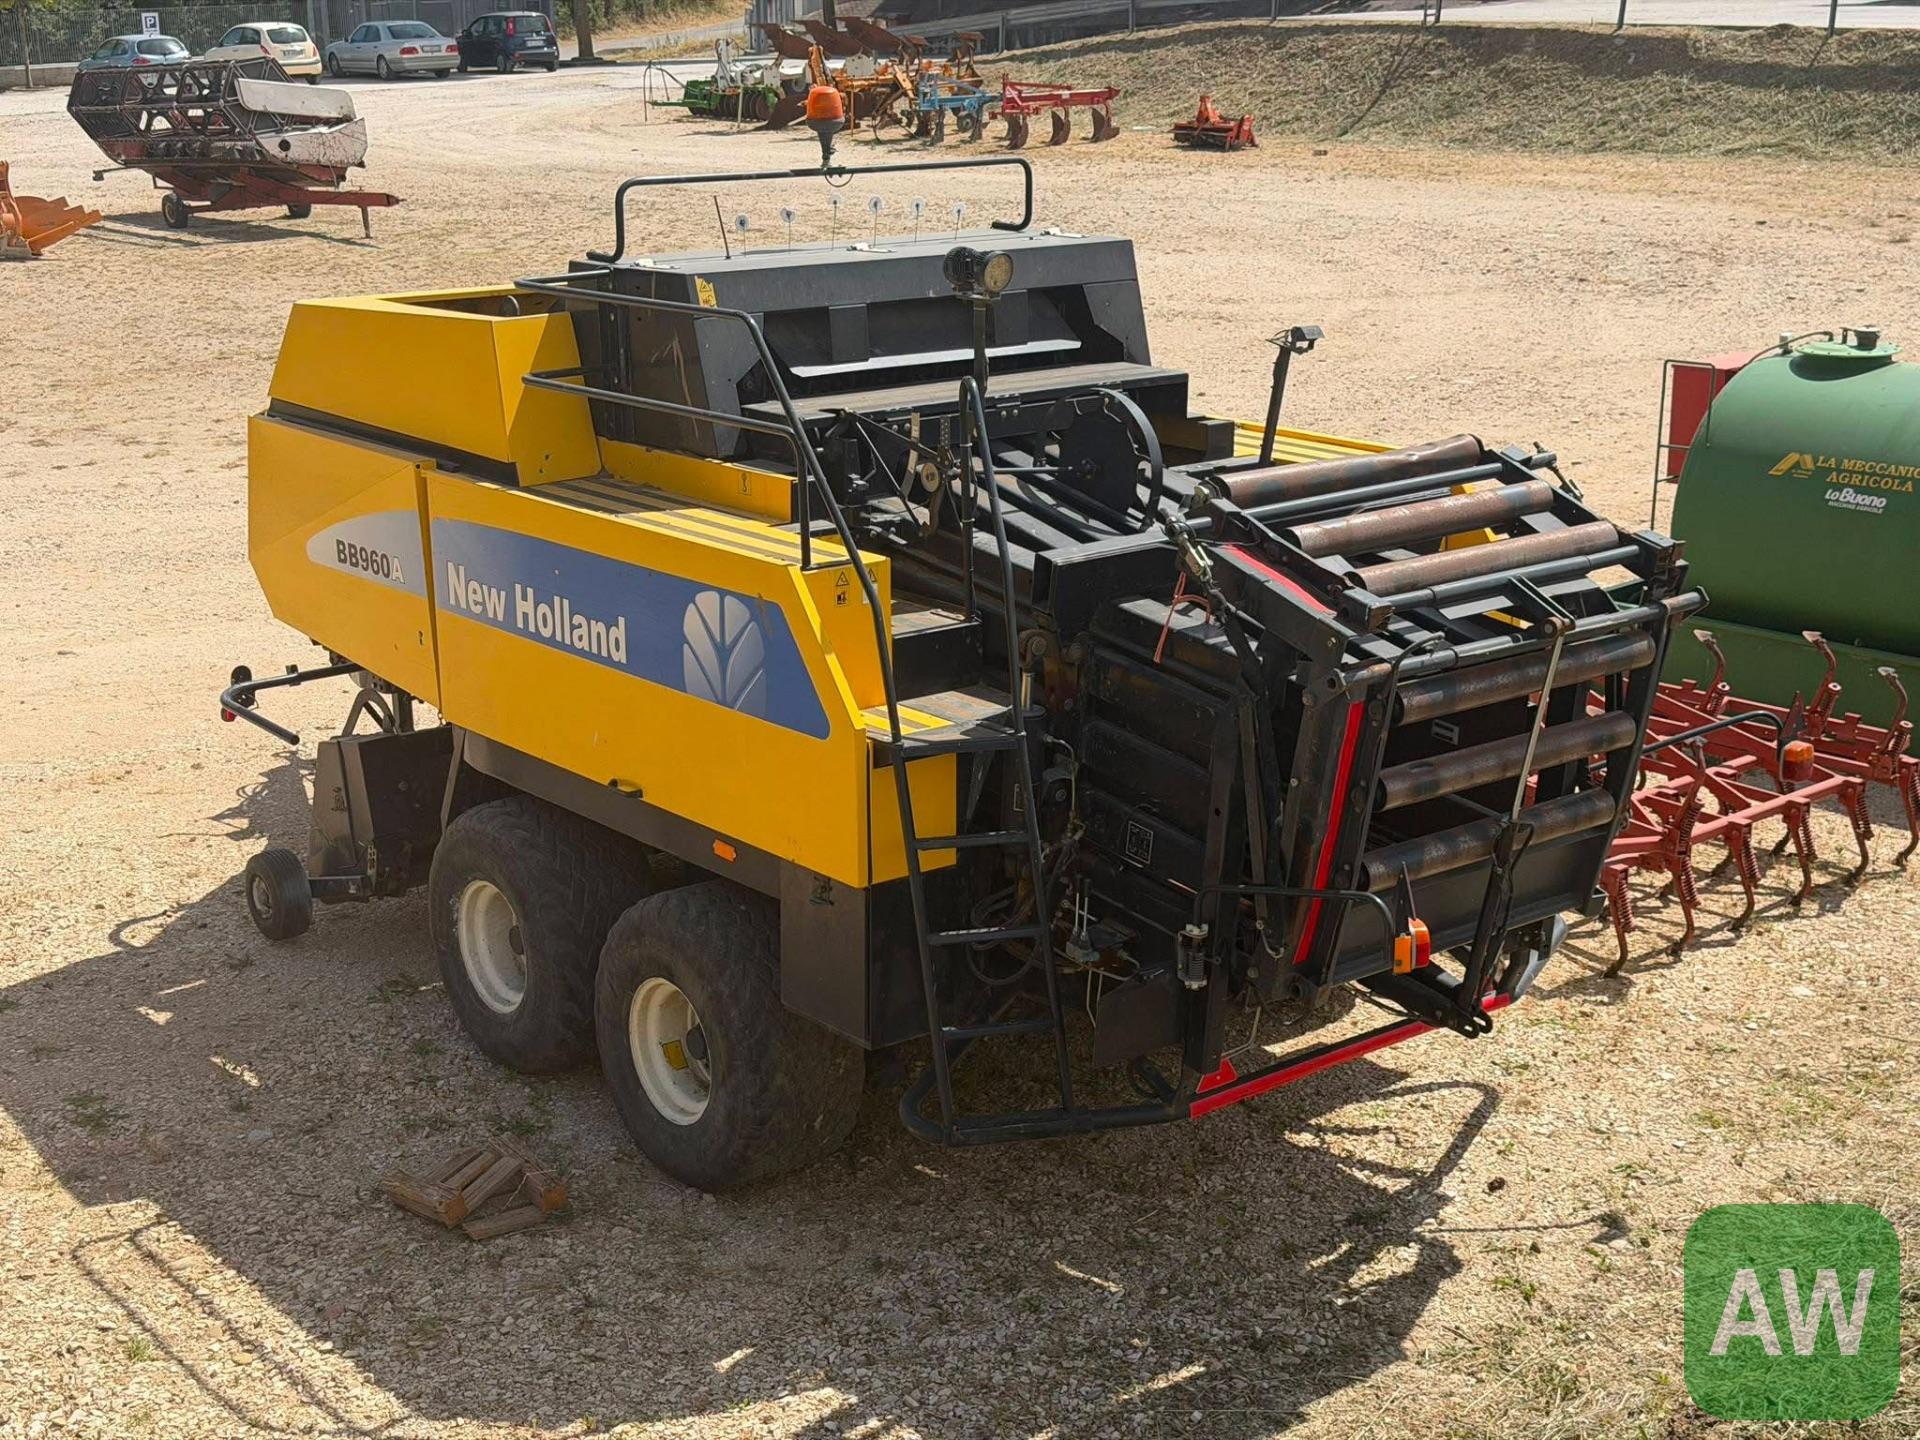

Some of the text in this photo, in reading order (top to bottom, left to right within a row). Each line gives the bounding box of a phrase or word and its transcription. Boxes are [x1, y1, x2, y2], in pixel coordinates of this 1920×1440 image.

[146, 17, 155, 28] P
[1816, 455, 1837, 469] LA
[1825, 471, 1914, 493] AGRICOLA
[336, 538, 406, 584] BB960A
[447, 561, 627, 664] New Holland
